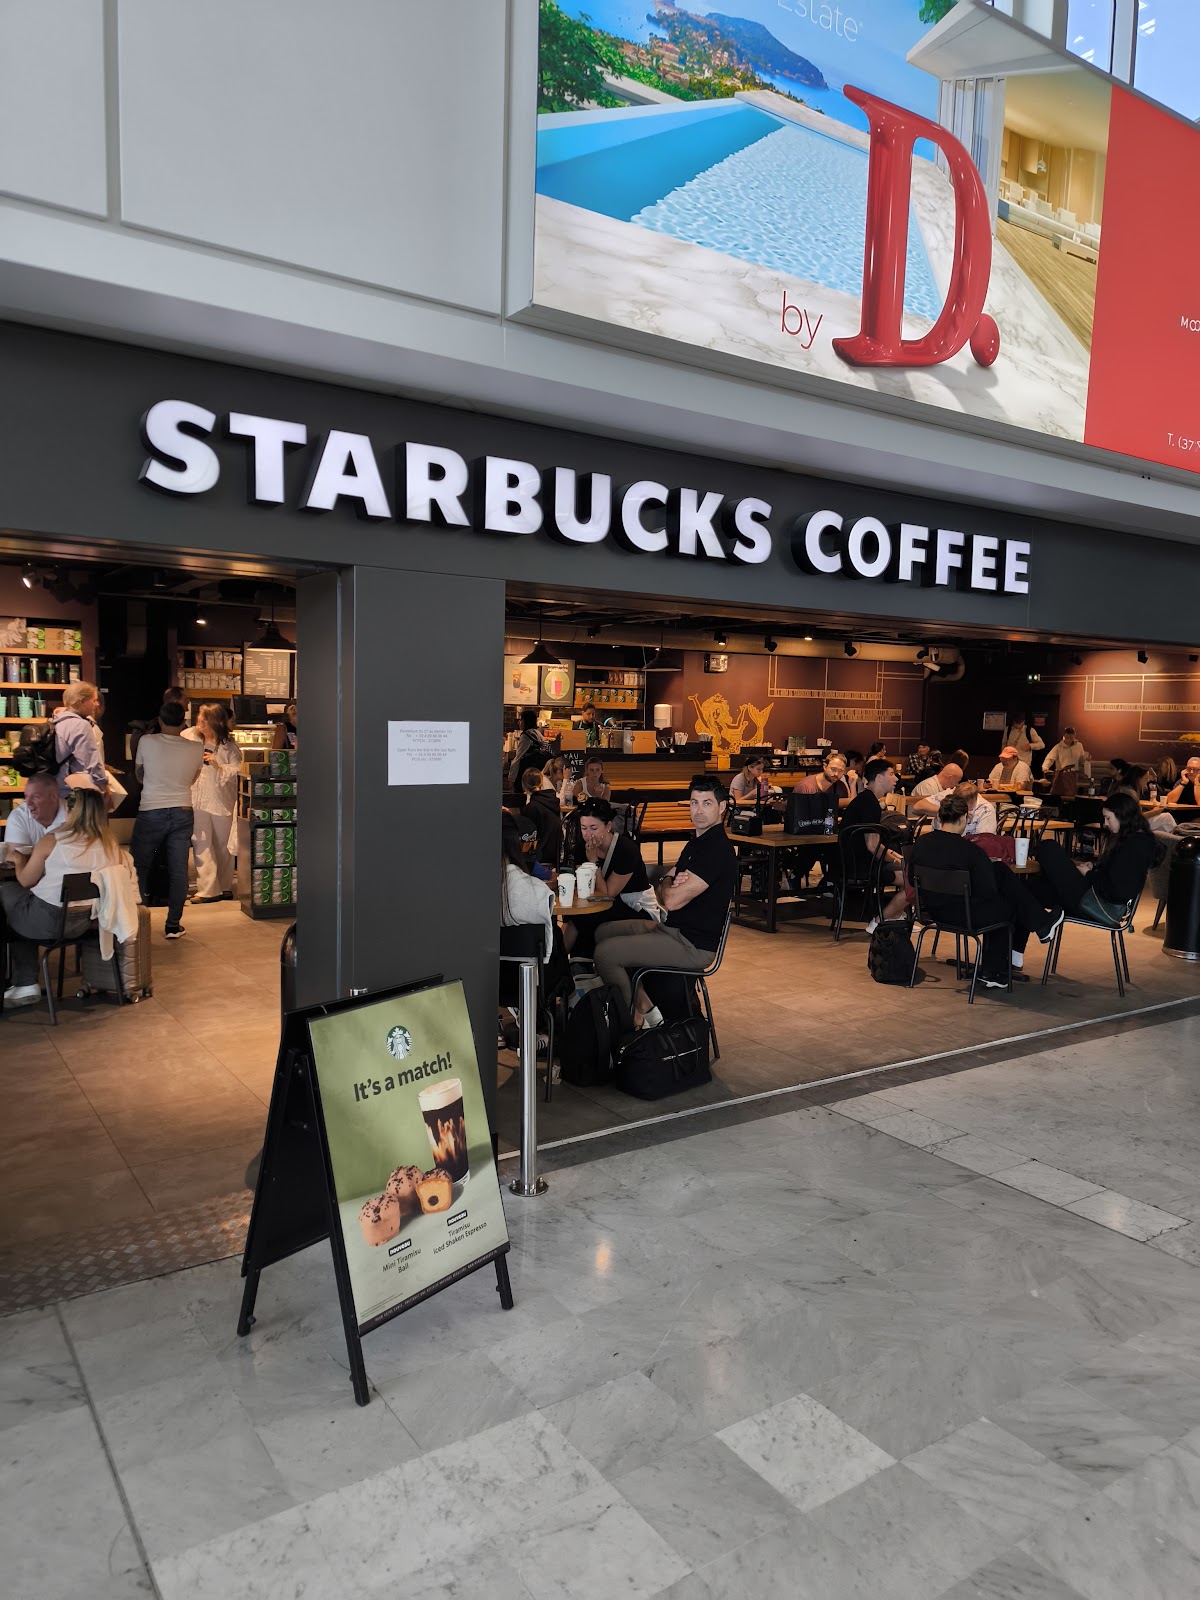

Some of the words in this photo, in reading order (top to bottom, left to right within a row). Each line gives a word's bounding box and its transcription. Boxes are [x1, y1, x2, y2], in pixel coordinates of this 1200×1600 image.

[781, 290, 823, 350] by
[140, 400, 773, 565] STARBUCKS
[798, 509, 1031, 595] COFFEE
[384, 1075, 395, 1092] a
[397, 1051, 453, 1077] match!
[447, 1210, 467, 1226] nouveau
[447, 1222, 471, 1238] Tiramisu
[445, 1232, 465, 1248] Shaken
[465, 1221, 488, 1238] Espresso
[389, 1239, 412, 1256] nouveau
[382, 1259, 396, 1273] Mini
[396, 1248, 422, 1265] Tiramisu
[397, 1261, 410, 1274] Ball
